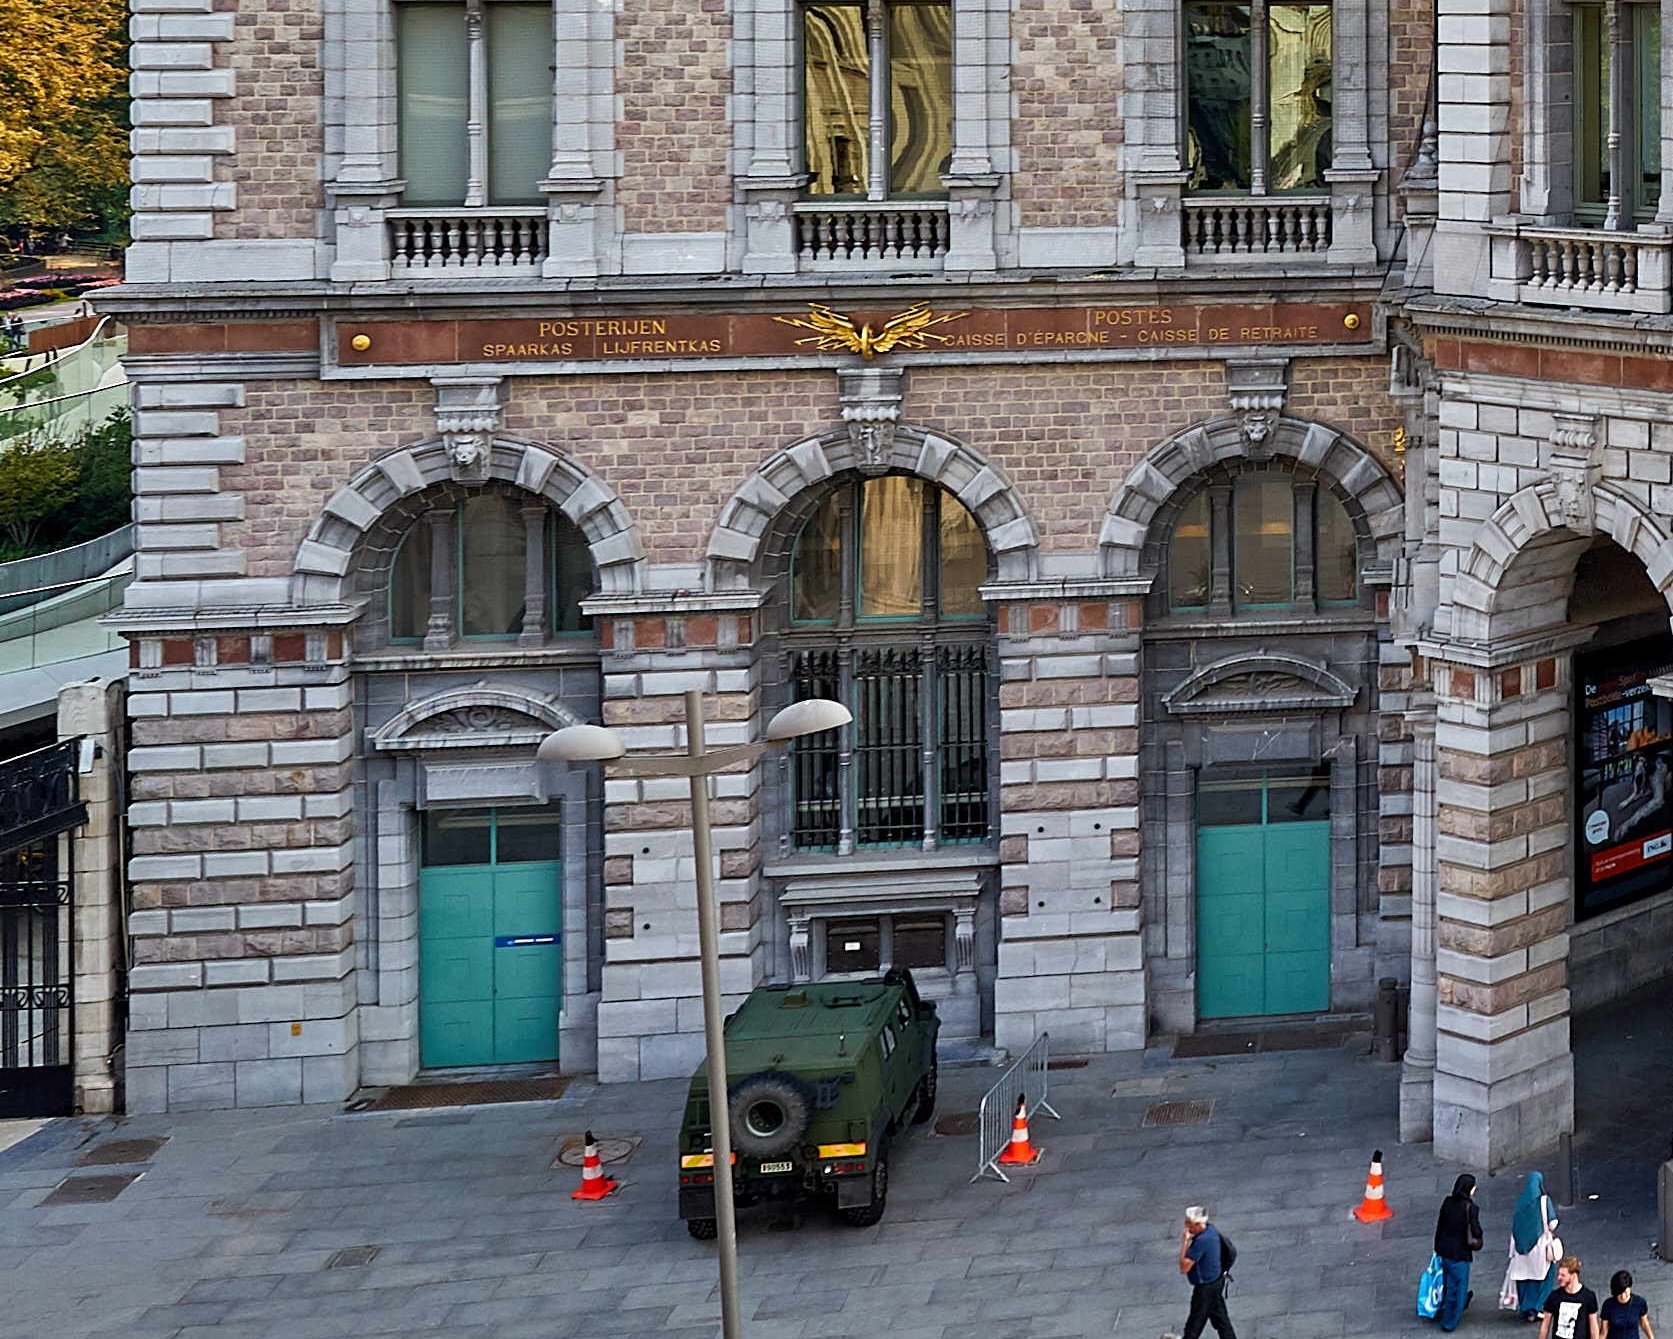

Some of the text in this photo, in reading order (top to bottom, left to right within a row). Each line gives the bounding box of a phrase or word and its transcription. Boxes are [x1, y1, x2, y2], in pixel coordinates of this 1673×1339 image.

[1095, 309, 1172, 326] POSTES
[540, 320, 666, 337] POSTERIJEN
[944, 333, 1005, 347] CAISSE
[1137, 329, 1197, 342] CAISSE
[1208, 328, 1229, 340] DE
[1241, 326, 1318, 339] RETRAITE
[483, 339, 721, 357] SPAARKAS LIJFRENTKAS
